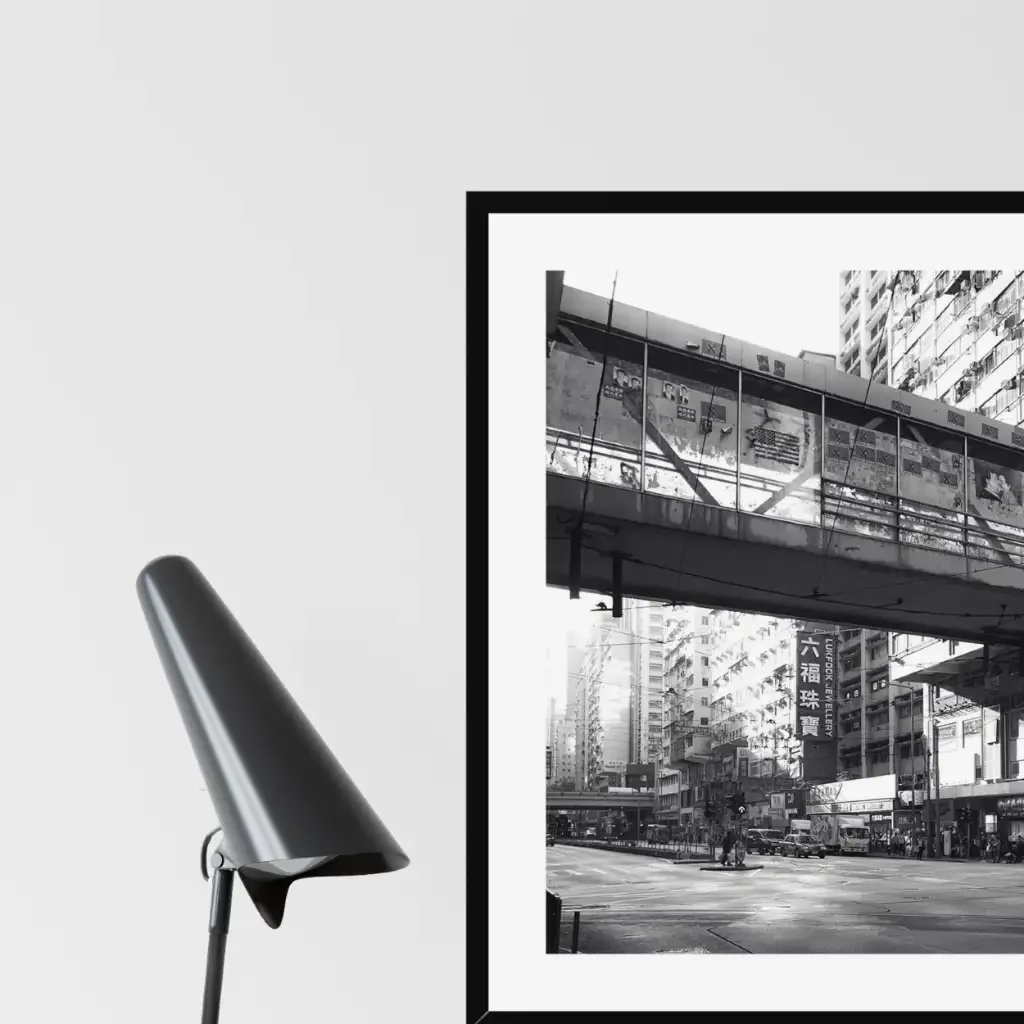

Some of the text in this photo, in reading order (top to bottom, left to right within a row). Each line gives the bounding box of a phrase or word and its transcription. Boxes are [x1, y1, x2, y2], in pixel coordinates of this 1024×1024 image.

[800, 636, 821, 737] 六福珠寶
[824, 638, 834, 737] LUKFOOK JEWELLERY
